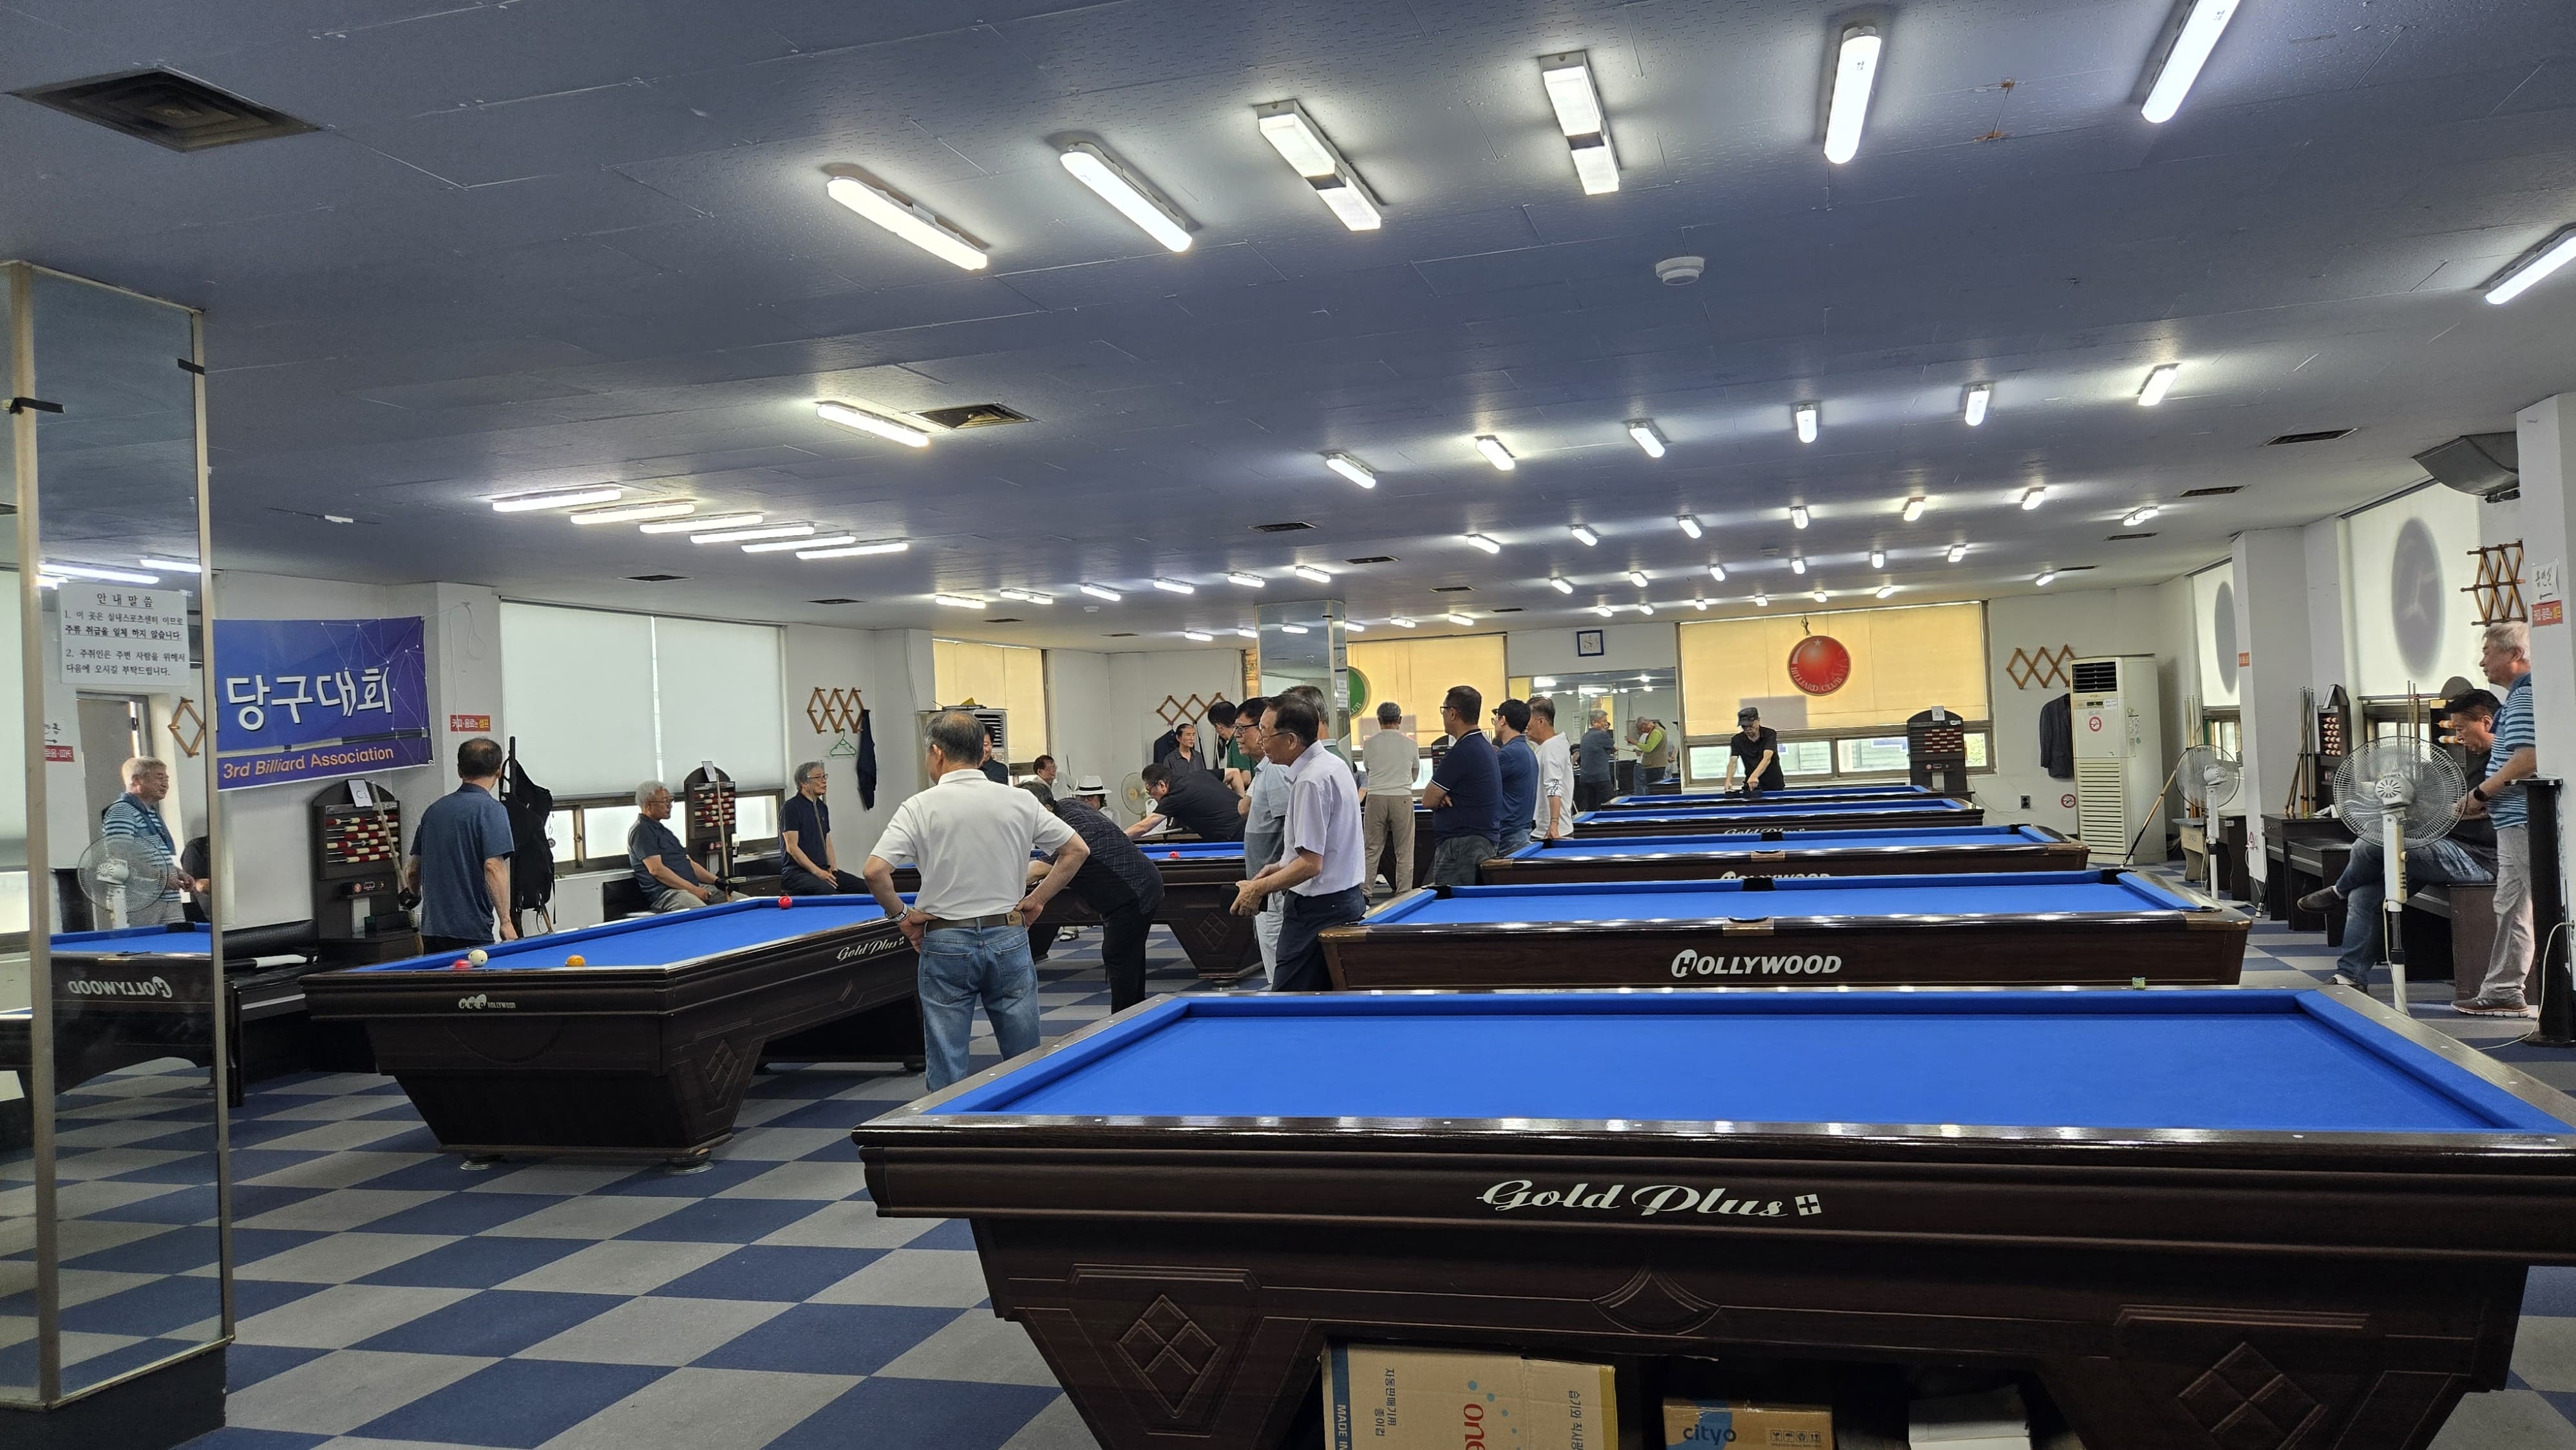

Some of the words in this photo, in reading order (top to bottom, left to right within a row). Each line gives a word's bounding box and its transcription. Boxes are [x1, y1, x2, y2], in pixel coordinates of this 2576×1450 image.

[65, 610, 71, 619] 1.
[77, 611, 84, 620] 이
[88, 612, 104, 621] 곳은
[108, 612, 158, 625] 실내스포츠센터
[162, 616, 184, 625] 이므로
[65, 625, 81, 634] 주류
[86, 626, 108, 636] 취급을
[113, 628, 128, 637] 일체
[132, 629, 146, 639] 하지
[66, 648, 74, 657] 2.
[80, 649, 112, 659] 주취인은
[116, 651, 131, 661] 주변
[136, 652, 159, 662] 사람을
[163, 653, 185, 663] 위해서
[66, 664, 90, 673] 다음에
[95, 664, 118, 675] 오시길
[1791, 667, 1819, 692] BILLIARD
[1821, 677, 1842, 692] CLUB
[227, 667, 392, 731] 당구대회
[223, 762, 250, 779] 3rd
[255, 756, 306, 775] Billiard
[311, 746, 394, 768] Association
[355, 790, 369, 800] C1
[836, 944, 869, 963] Gold
[868, 938, 898, 955] Plus
[1671, 949, 1842, 977] HOLLYWOOD
[1476, 1180, 1624, 1210] Gold
[1631, 1185, 1788, 1217] Plus
[1385, 1368, 1397, 1426] 자동판매기용
[1569, 1390, 1582, 1418] 습기와
[1337, 1404, 1348, 1438] MADE
[1374, 1408, 1385, 1436] 종이컵
[1683, 1424, 1737, 1445] cityo
